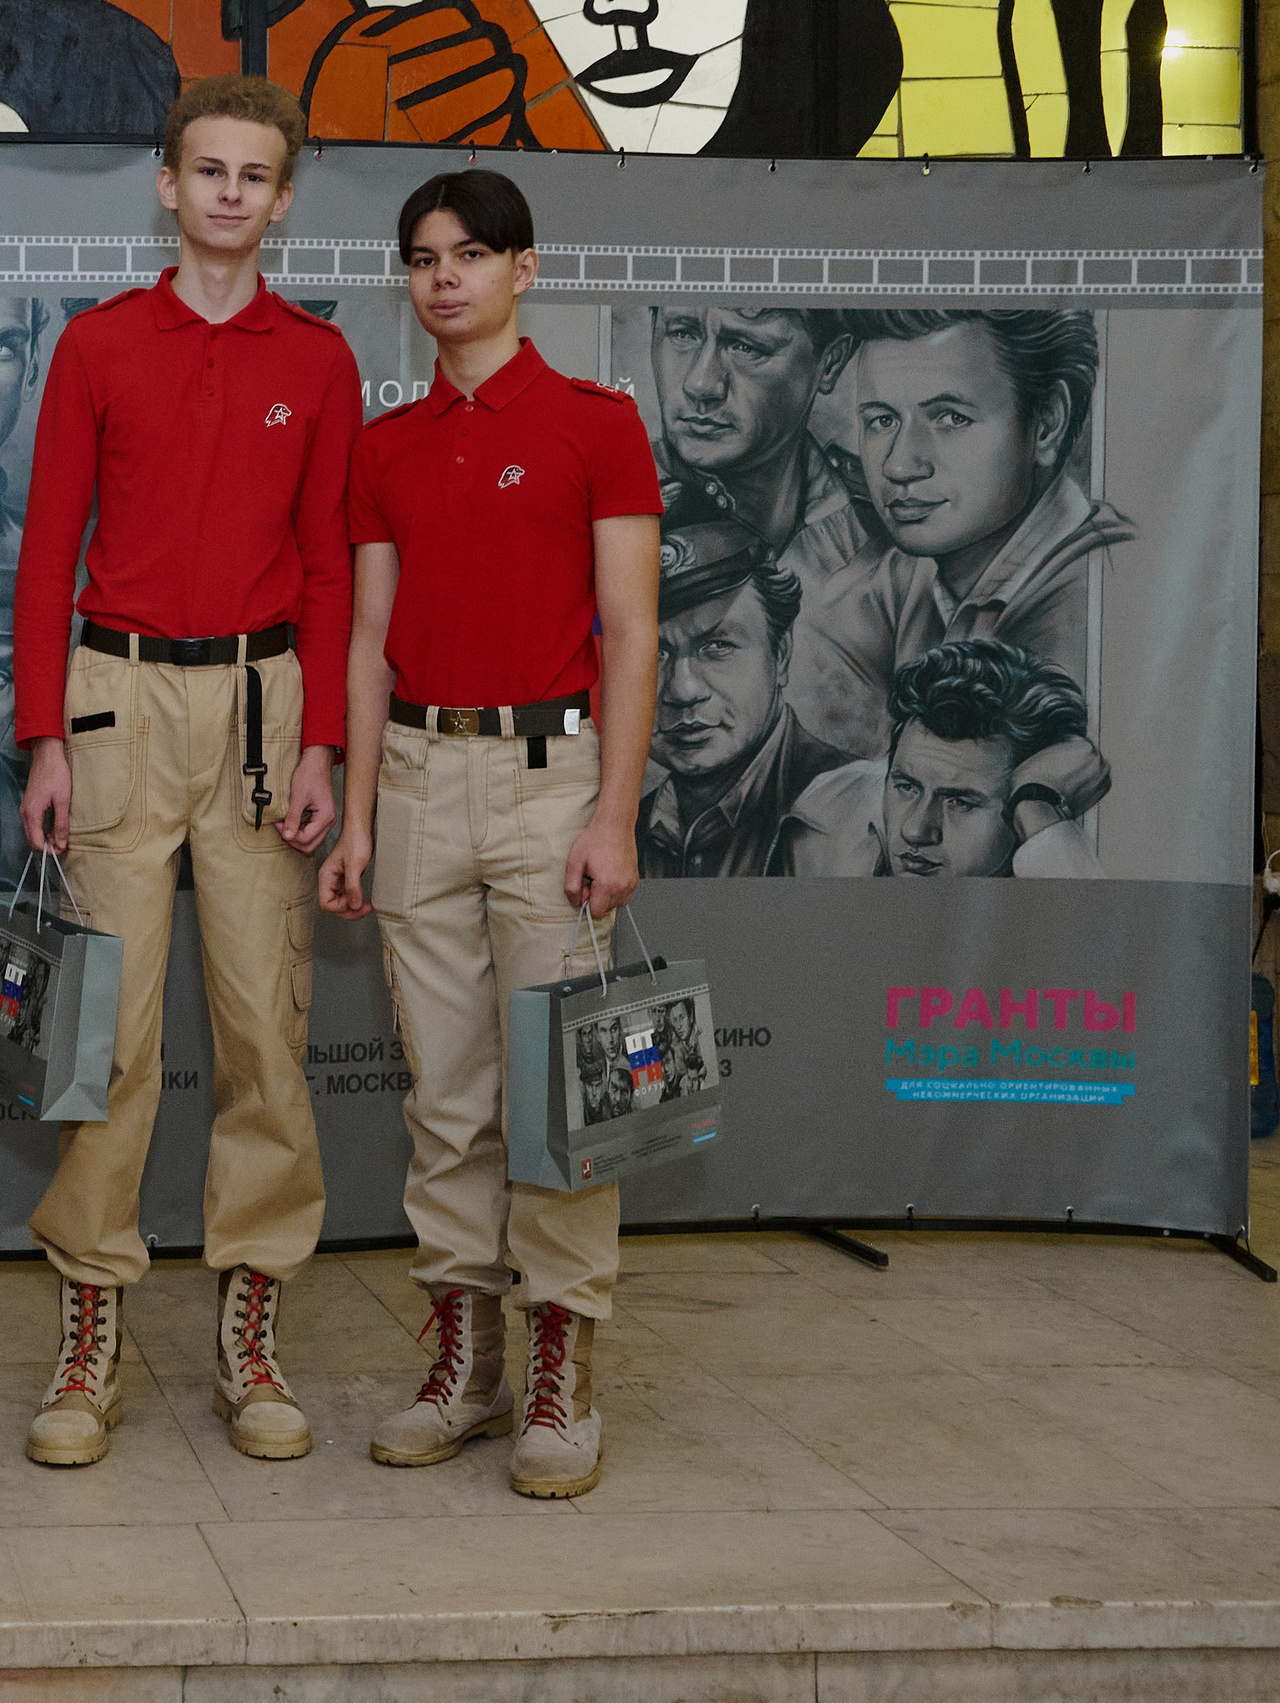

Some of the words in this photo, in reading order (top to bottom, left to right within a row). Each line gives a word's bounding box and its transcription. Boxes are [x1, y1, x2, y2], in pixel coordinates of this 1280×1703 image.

[886, 986, 1136, 1032] ГРАНТЫ
[307, 1037, 384, 1064] ЬШОЙ
[885, 1037, 978, 1073] Мэра
[990, 1037, 1135, 1070] Москвы
[162, 1071, 198, 1089] КИ
[326, 1071, 413, 1095] МОСКВ
